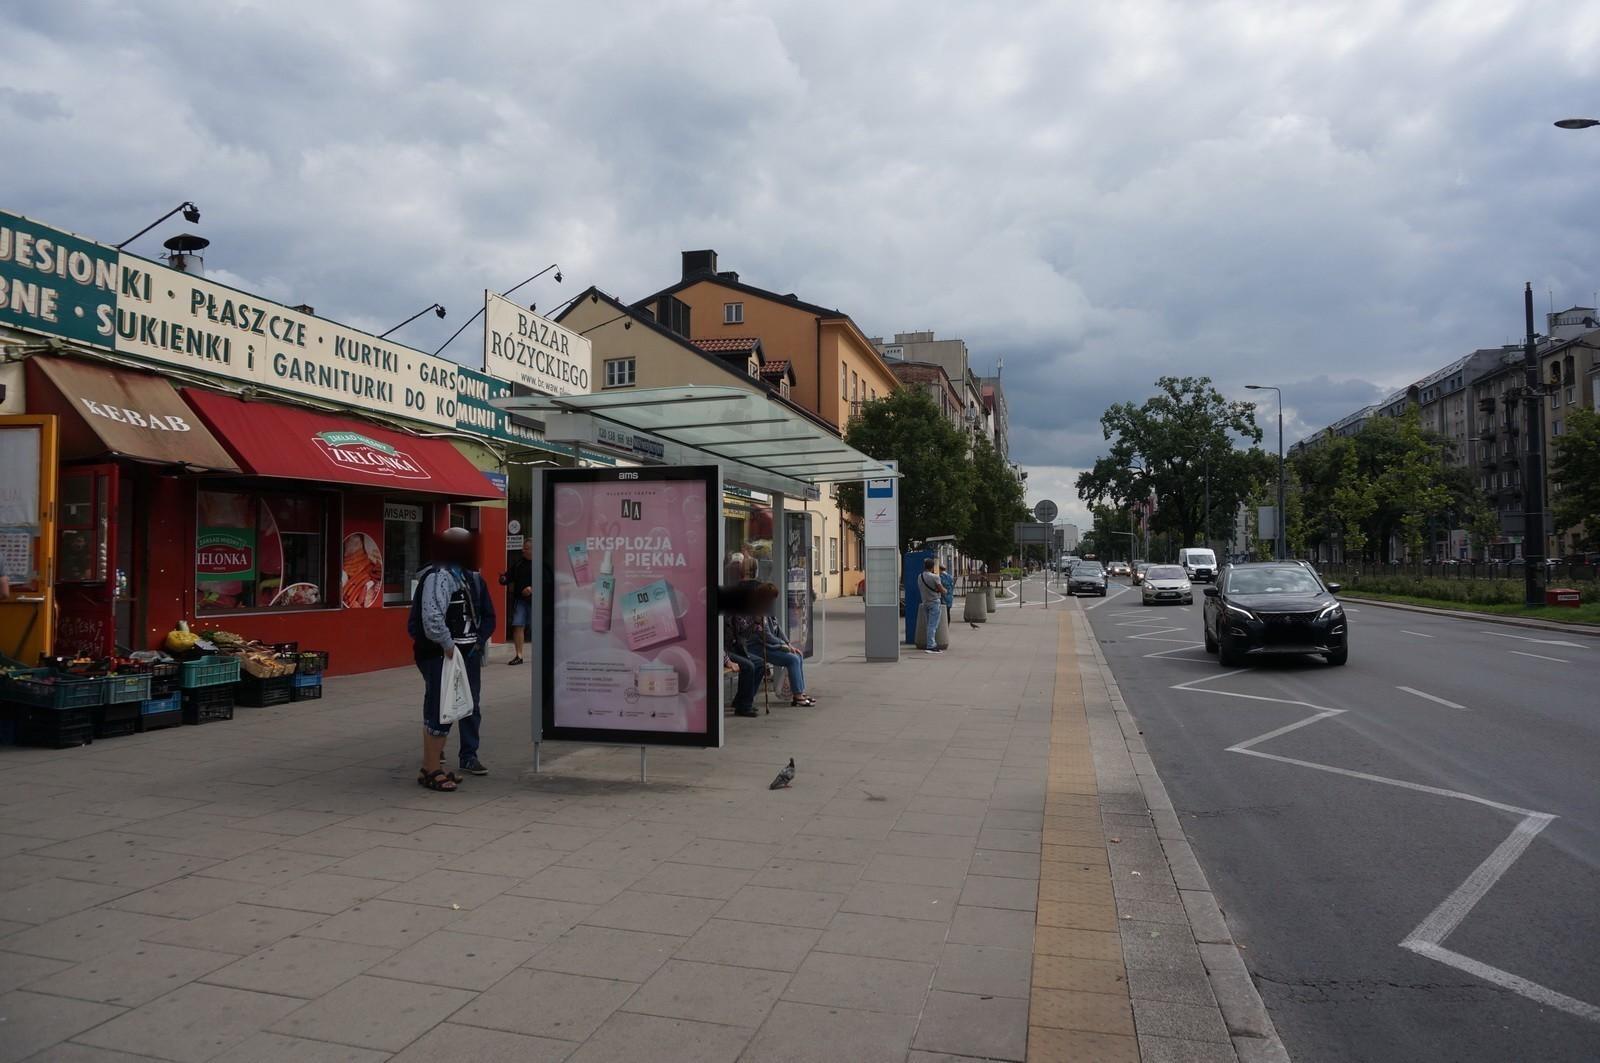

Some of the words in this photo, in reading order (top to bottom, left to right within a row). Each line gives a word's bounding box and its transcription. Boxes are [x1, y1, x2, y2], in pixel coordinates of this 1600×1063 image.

[190, 287, 306, 348] PŁASZCZE
[334, 335, 399, 375] KURTKI
[419, 362, 490, 402] GARSONKI
[517, 312, 570, 357] BAZAR
[96, 303, 231, 366] SUKIENKI
[247, 344, 256, 371] i
[273, 352, 394, 405] GARNITURKI
[405, 386, 426, 411] DO
[436, 392, 496, 431] KOMUNII
[490, 330, 589, 391] RÓŻYCKIEGO
[81, 397, 191, 433] KEBAB
[328, 447, 420, 473] ZIELONKA
[618, 471, 639, 480] ams
[621, 499, 641, 520] AA
[585, 536, 672, 551] EKSPLOZJA
[624, 552, 687, 570] PIĘKNA
